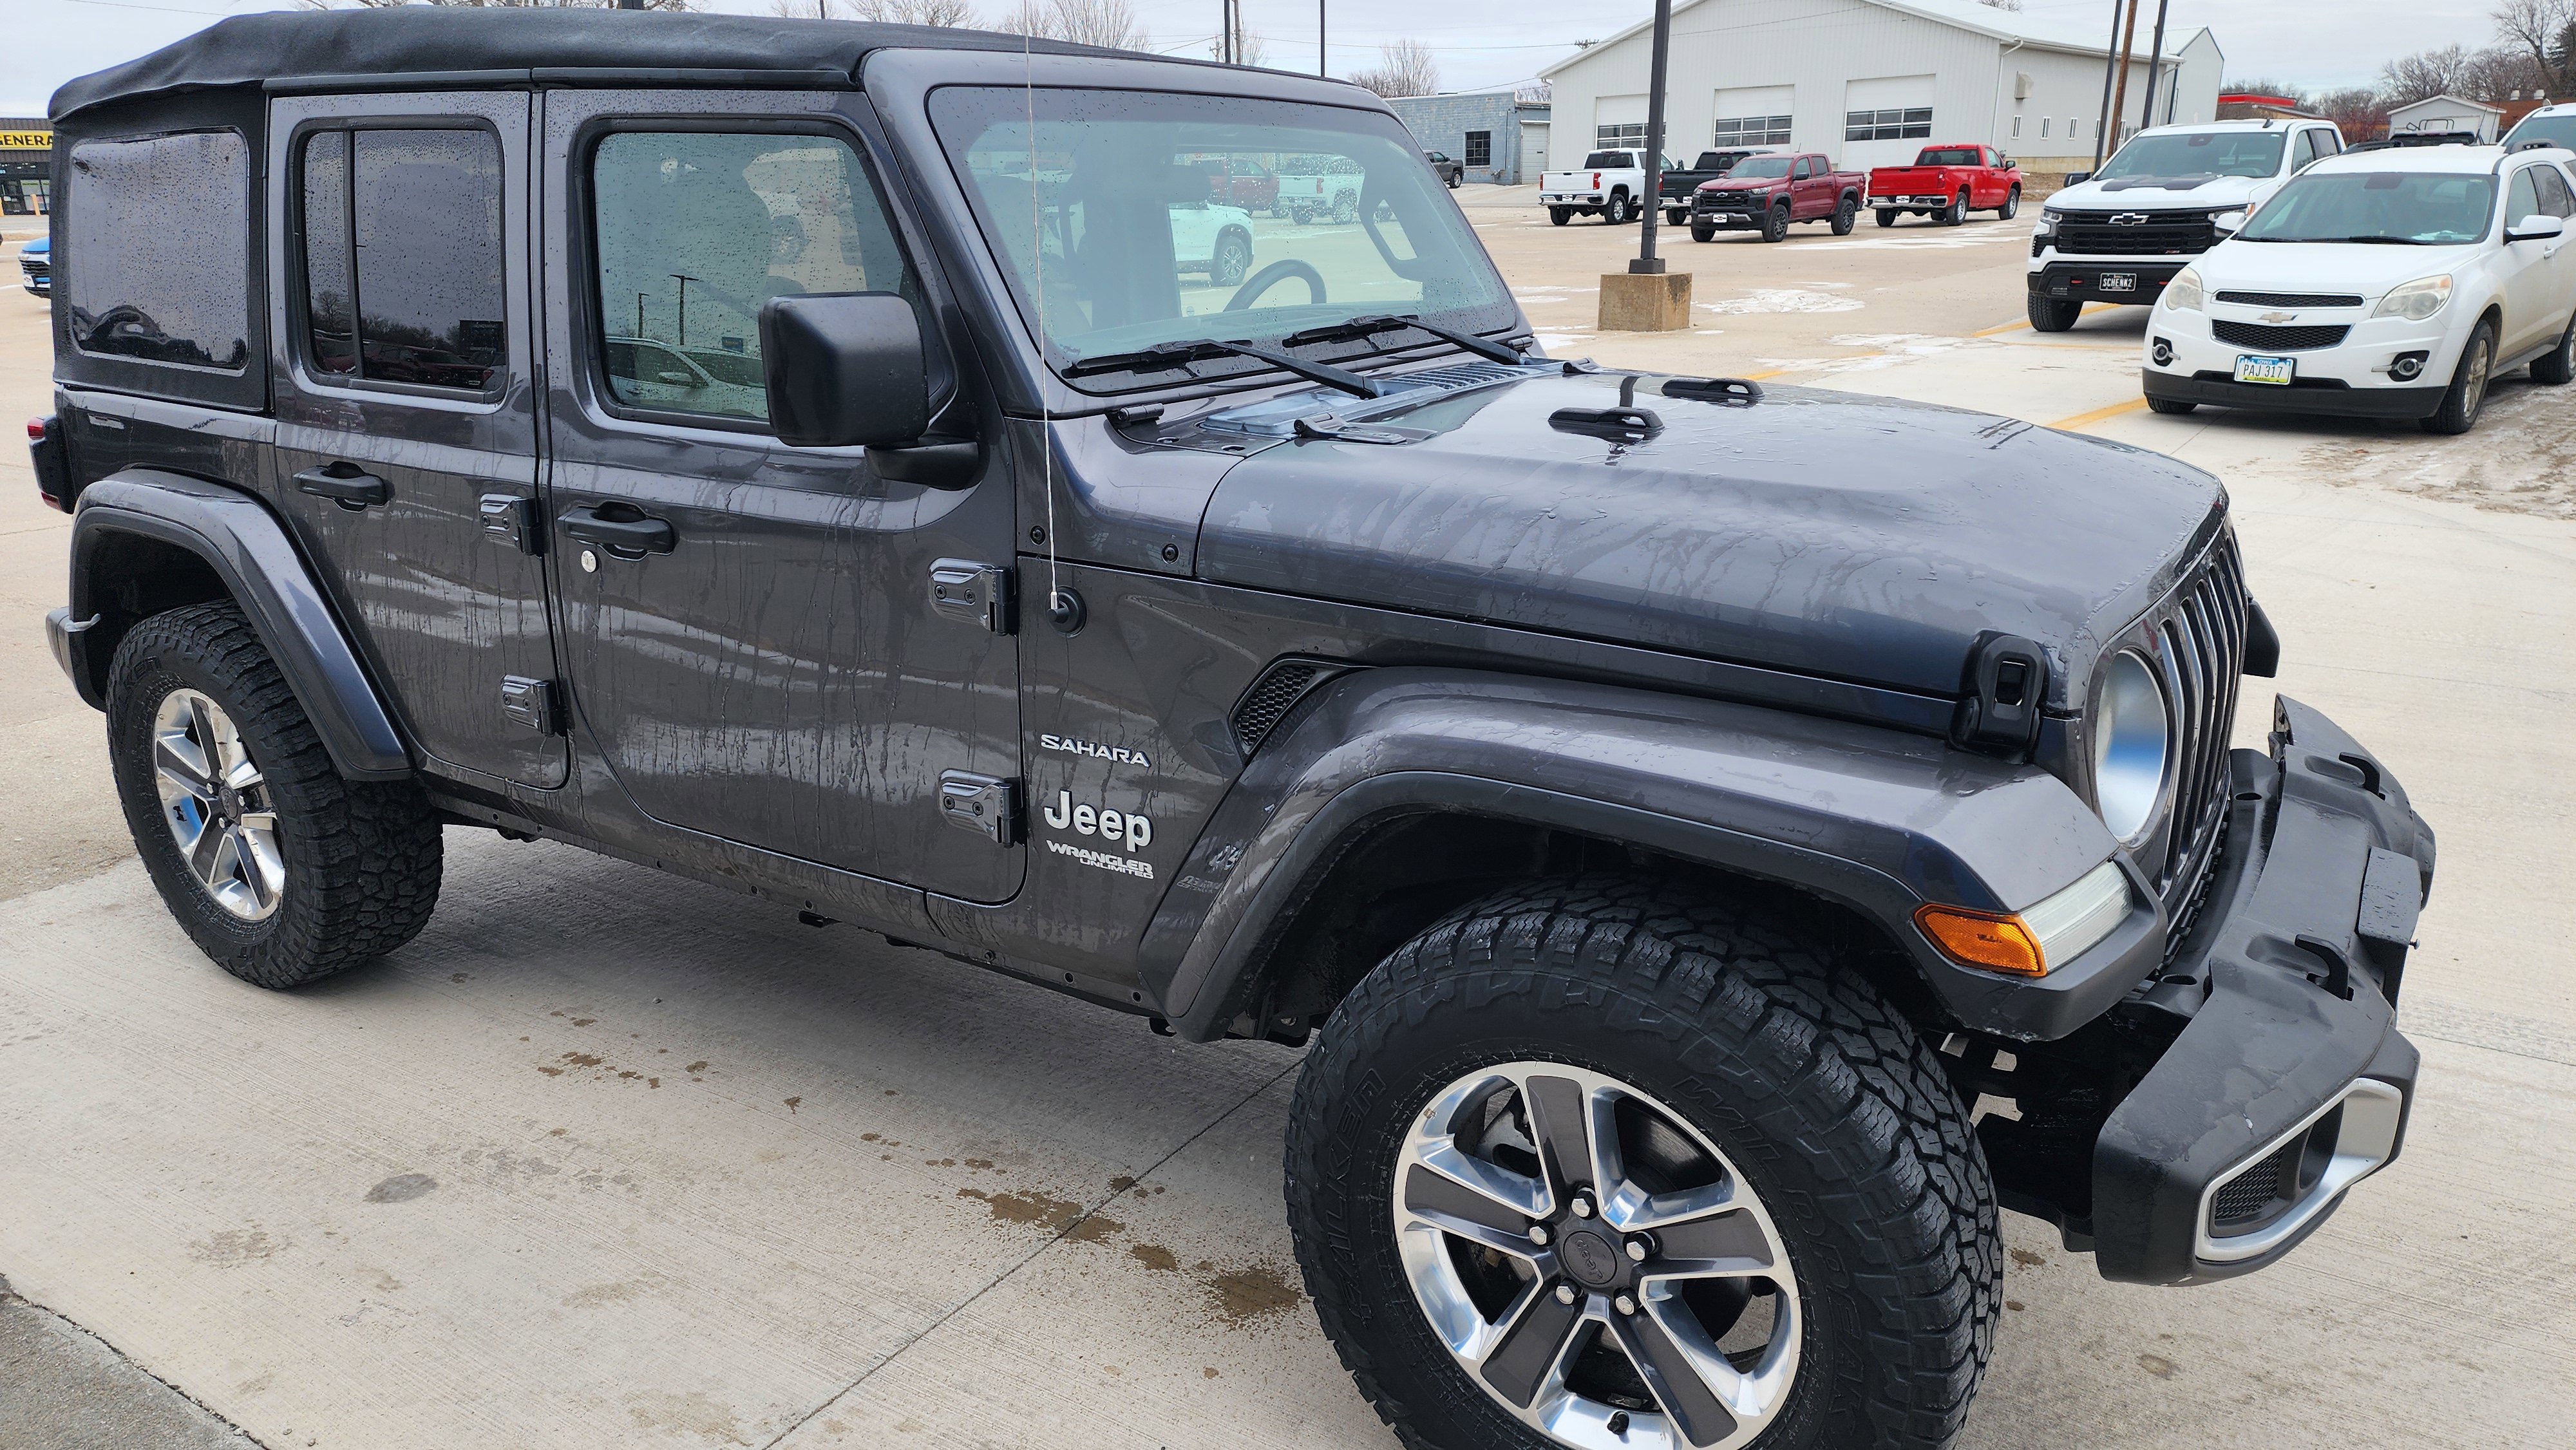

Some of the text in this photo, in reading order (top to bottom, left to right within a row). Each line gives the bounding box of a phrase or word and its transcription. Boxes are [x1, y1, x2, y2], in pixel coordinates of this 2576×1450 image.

[2103, 278, 2133, 288] SCHENK2
[2243, 364, 2283, 379] PAJ 317
[1041, 734, 1151, 767] SAHARA
[1044, 790, 1153, 852] Jeep
[1046, 840, 1153, 873] WRANGLER
[1079, 858, 1154, 880] UNLIMITED
[1327, 1068, 1387, 1317] FALKEN
[1575, 1239, 1603, 1279] Jeep
